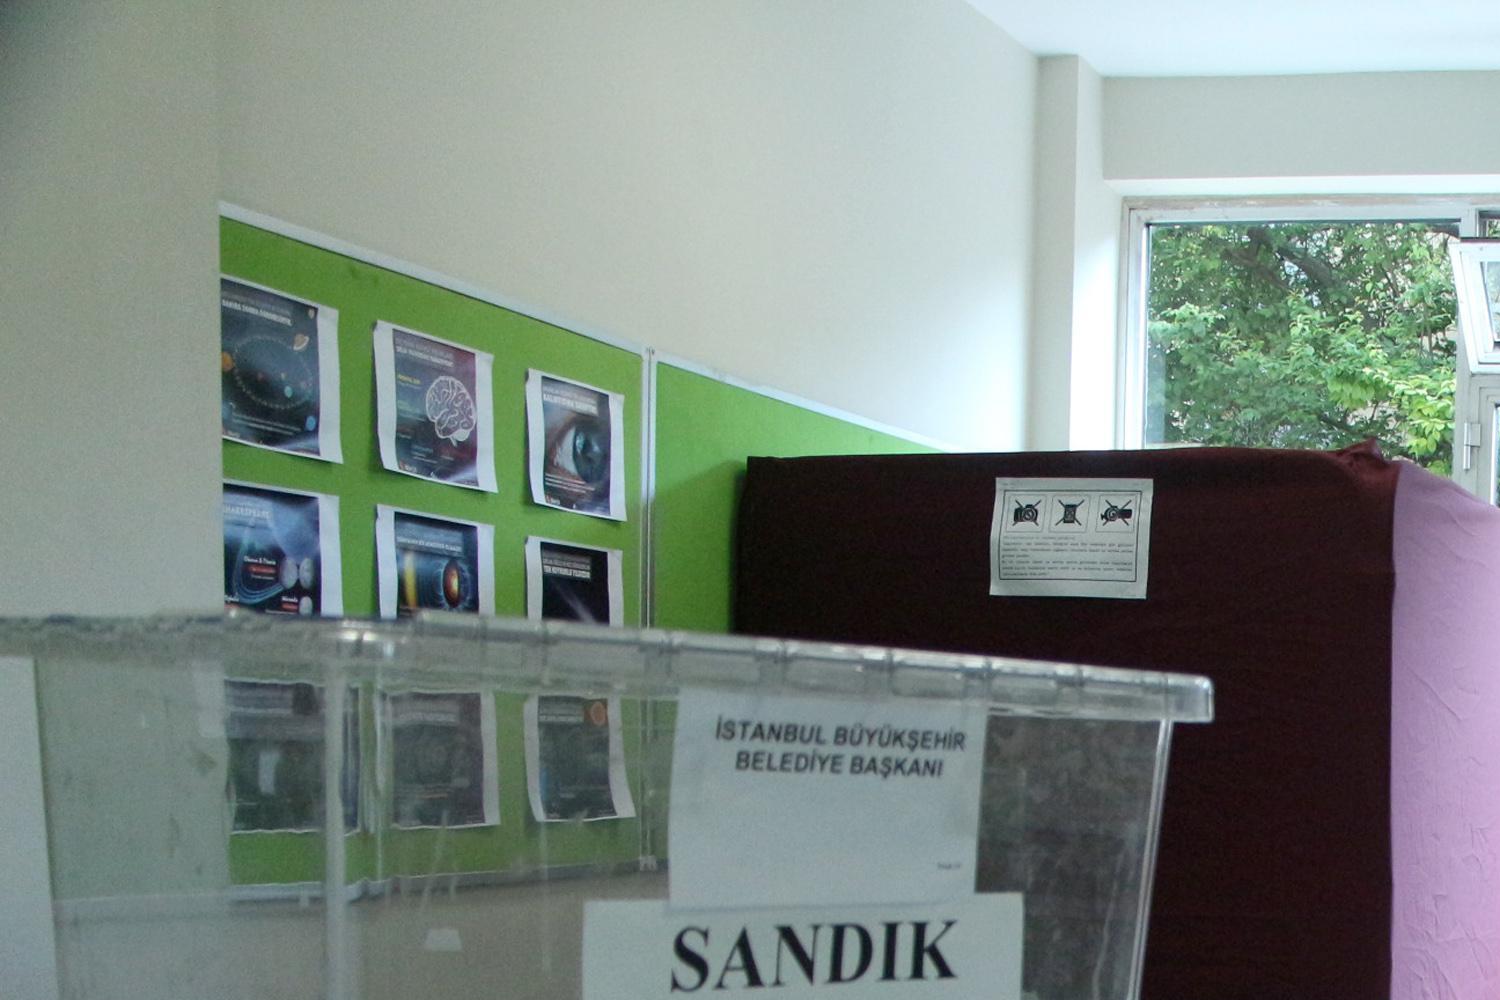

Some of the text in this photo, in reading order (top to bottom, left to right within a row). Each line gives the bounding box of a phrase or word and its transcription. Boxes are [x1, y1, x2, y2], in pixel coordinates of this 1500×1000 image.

[715, 715, 967, 752] İSTANBUL BÜYÜKŞEHİR
[735, 750, 944, 780] BELEDİYE BAŞKANI
[670, 919, 959, 994] SANDIK
